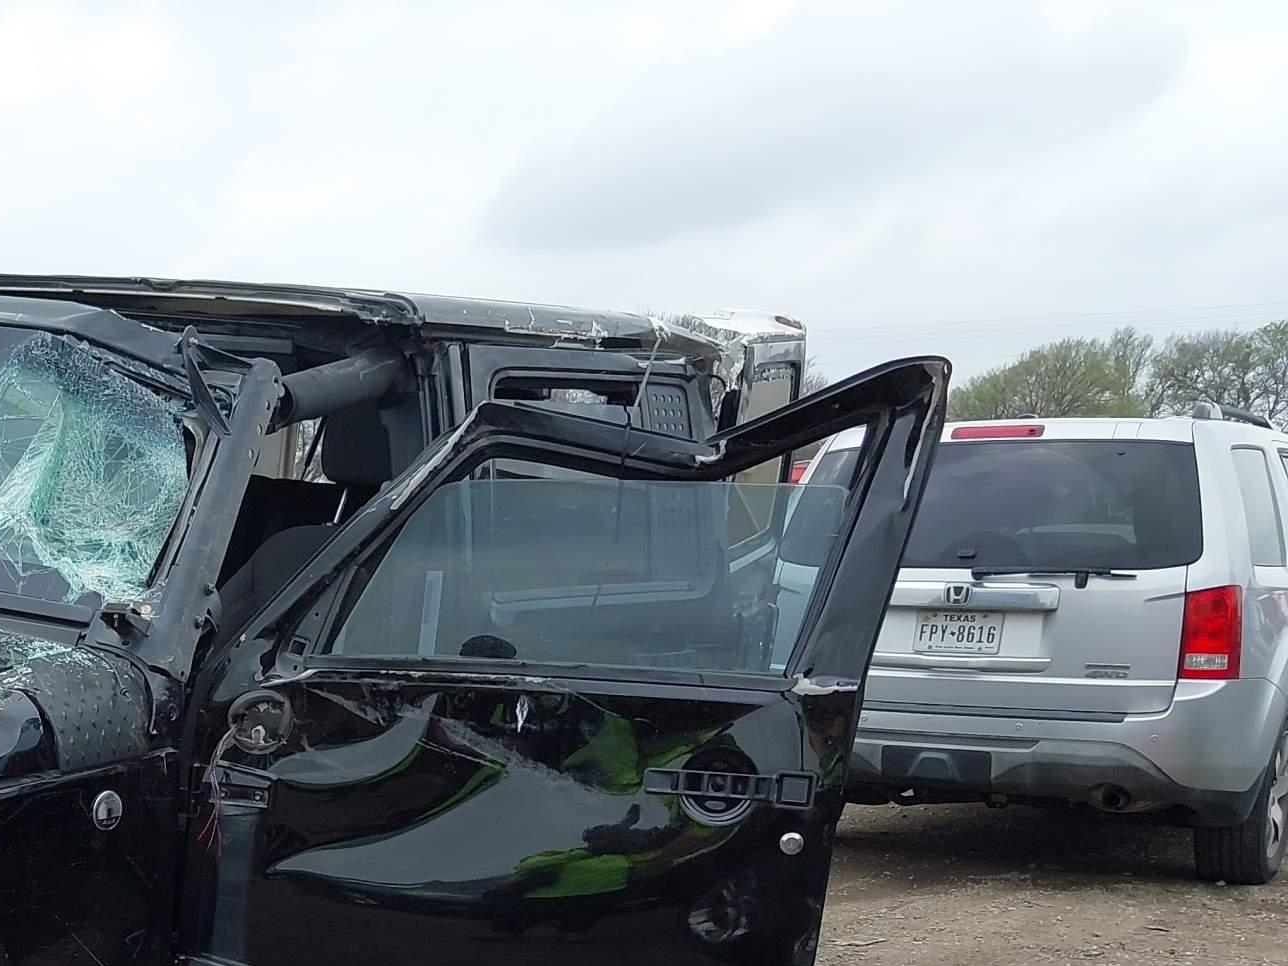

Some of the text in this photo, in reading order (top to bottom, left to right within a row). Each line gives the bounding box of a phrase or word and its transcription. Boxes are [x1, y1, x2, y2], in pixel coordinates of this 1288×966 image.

[943, 614, 977, 623] TEXAS
[918, 623, 997, 644] FPY 8616
[1084, 670, 1129, 679] 4WD
